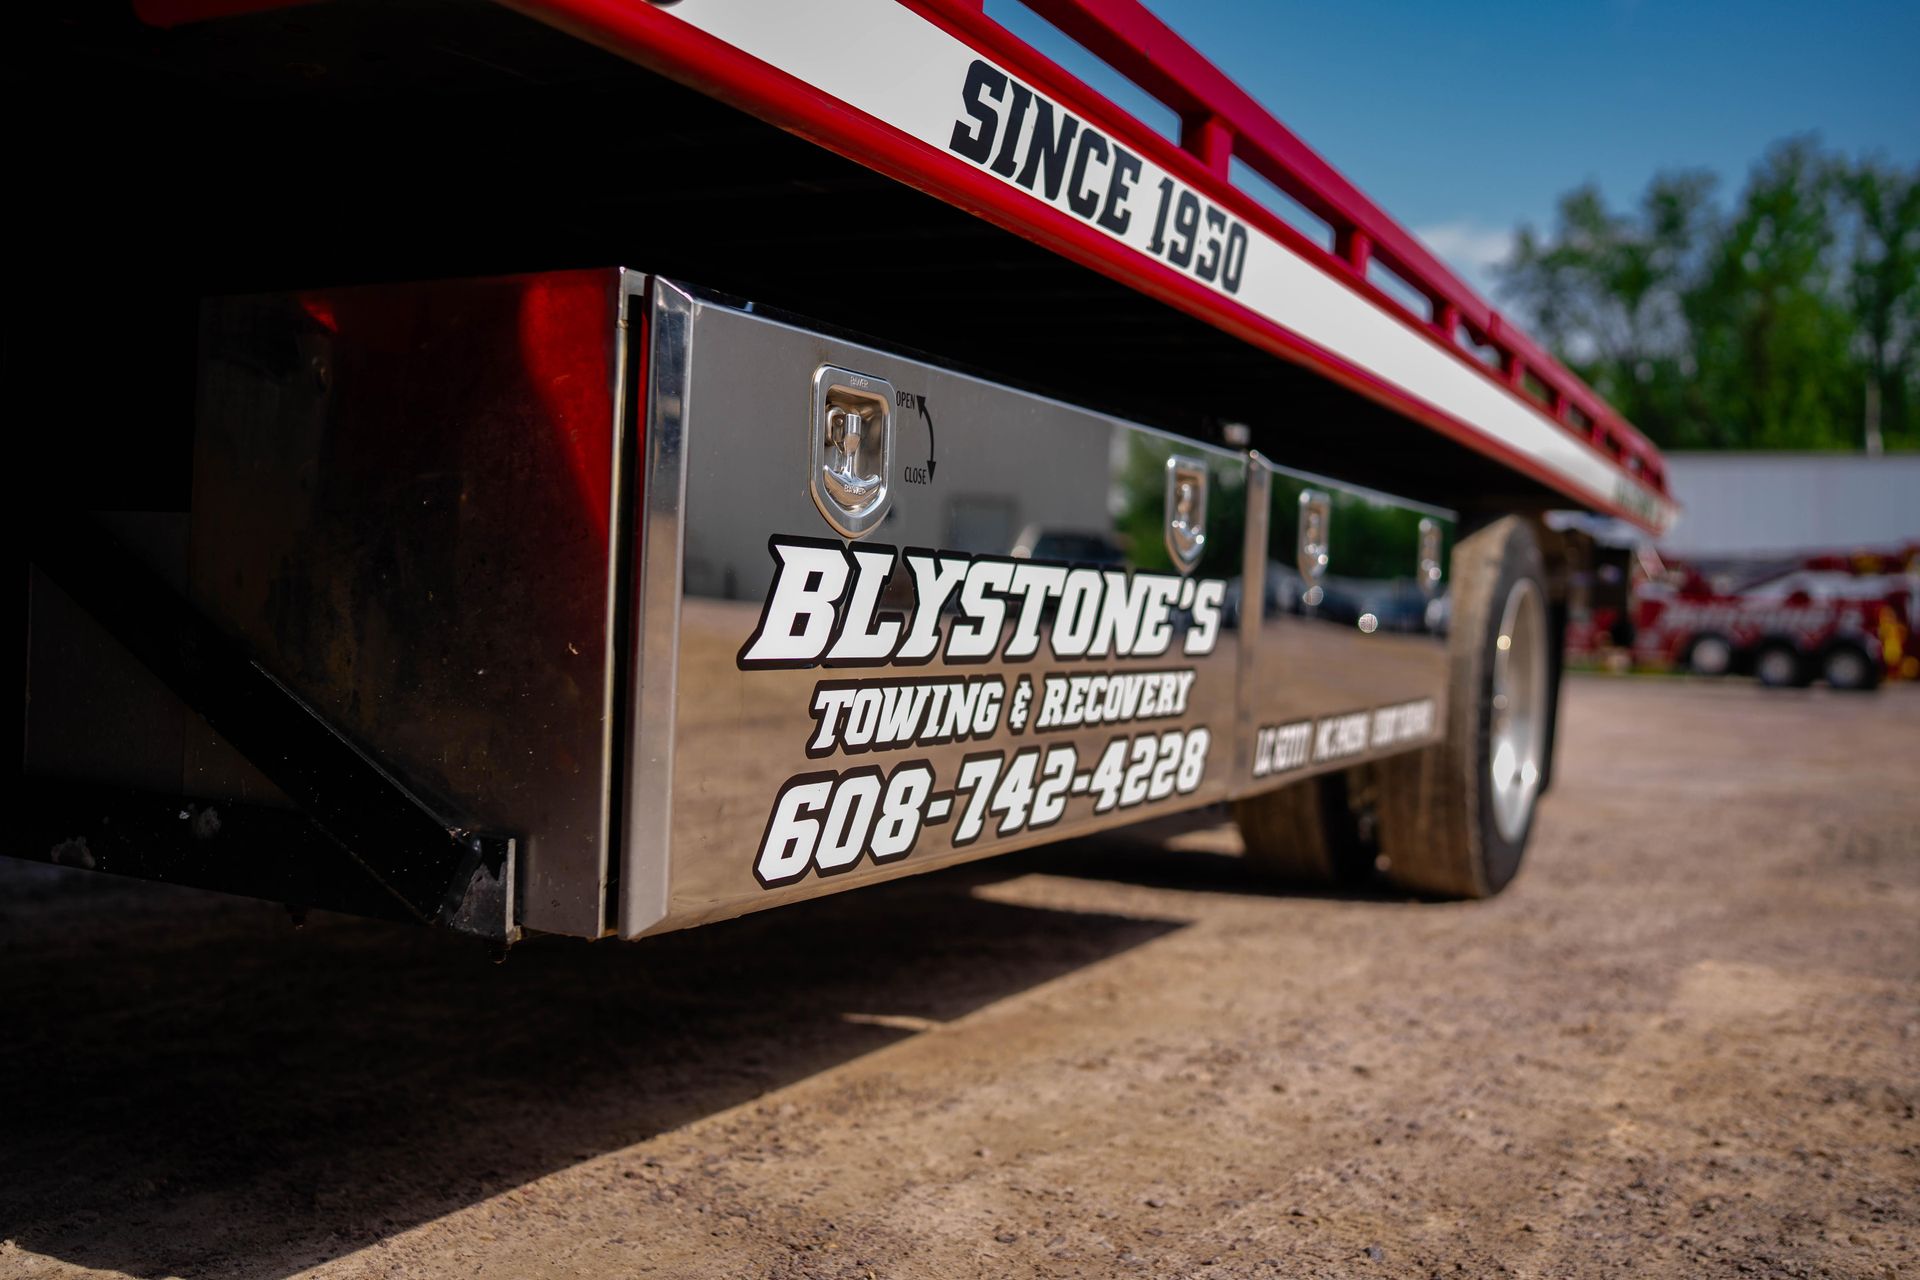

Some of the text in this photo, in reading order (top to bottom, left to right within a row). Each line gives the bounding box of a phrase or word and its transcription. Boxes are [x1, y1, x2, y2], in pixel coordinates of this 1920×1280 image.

[949, 59, 1143, 236] SINCE
[896, 391, 915, 410] OPEN
[904, 466, 927, 485] CLOSE
[741, 543, 1227, 661] BLYSTONE'S
[810, 670, 1197, 751] TOWING & RECOVERY
[755, 728, 1212, 883] 608-742-4228
